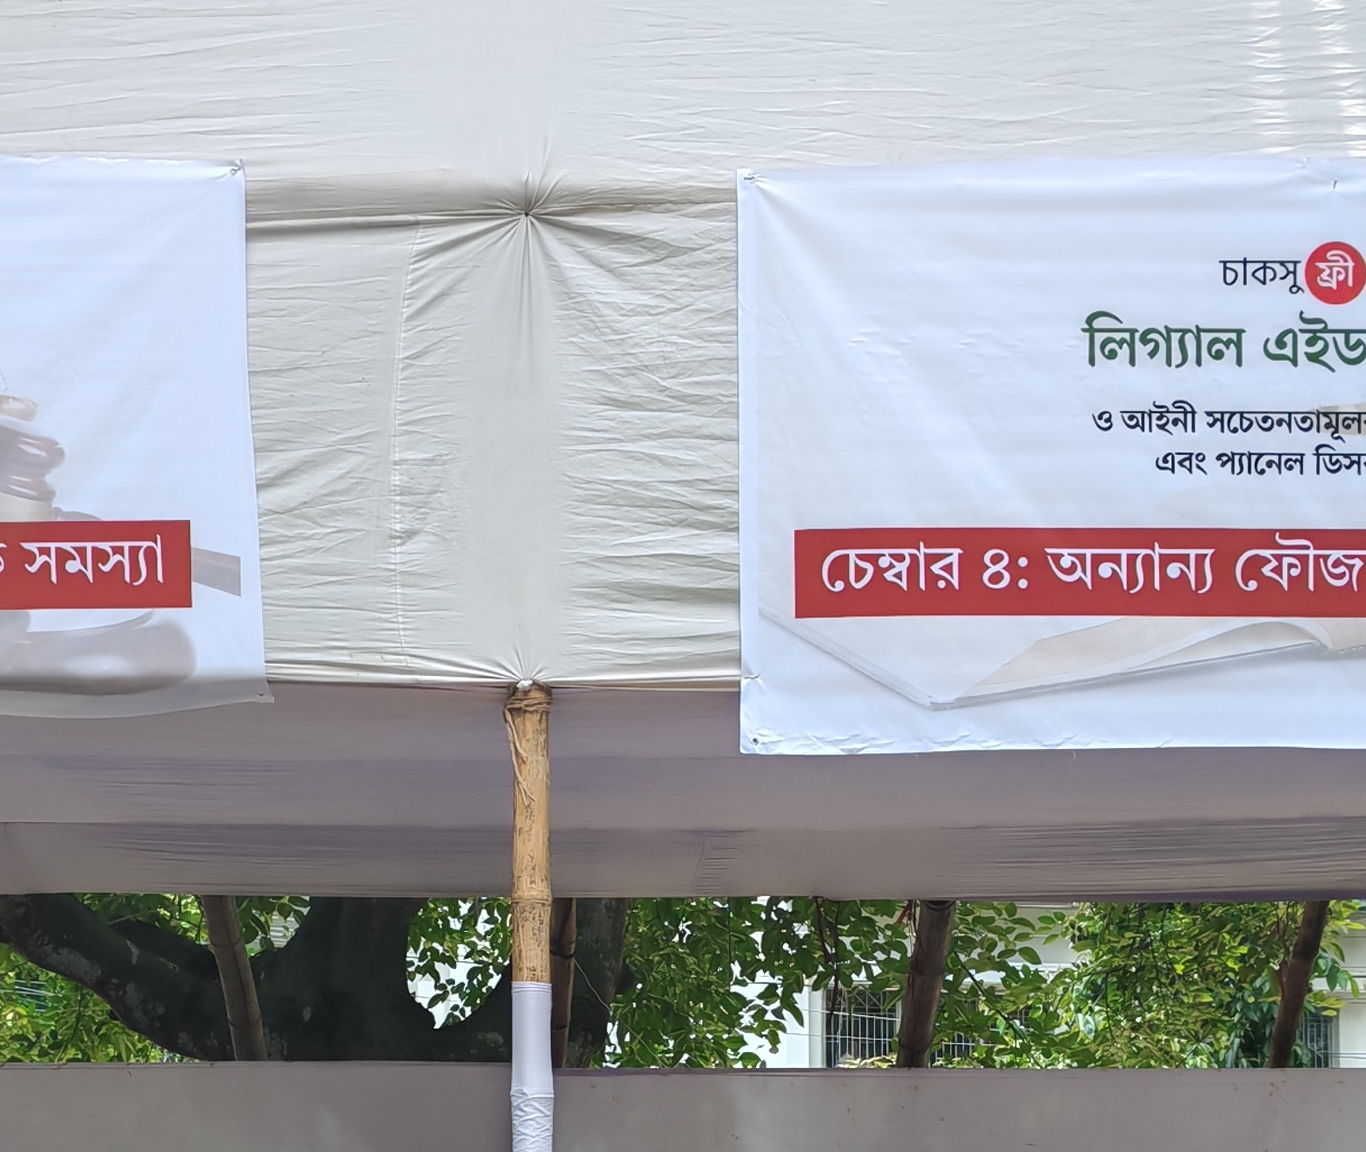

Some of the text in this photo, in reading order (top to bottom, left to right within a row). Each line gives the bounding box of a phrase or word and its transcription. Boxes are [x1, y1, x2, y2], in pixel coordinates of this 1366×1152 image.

[1218, 250, 1355, 295] চাকসু ফ্রী
[1080, 310, 1247, 369] লিগ্যাল
[1092, 410, 1114, 432] ও
[1119, 399, 1198, 436] আইনী
[1155, 451, 1208, 475] এবং
[1215, 450, 1306, 476] প্যানেল
[19, 534, 164, 586] সমস্যা
[821, 541, 964, 592] চেম্বার
[982, 548, 1028, 589] ৪:
[1044, 541, 1215, 594] অন্যান্য
